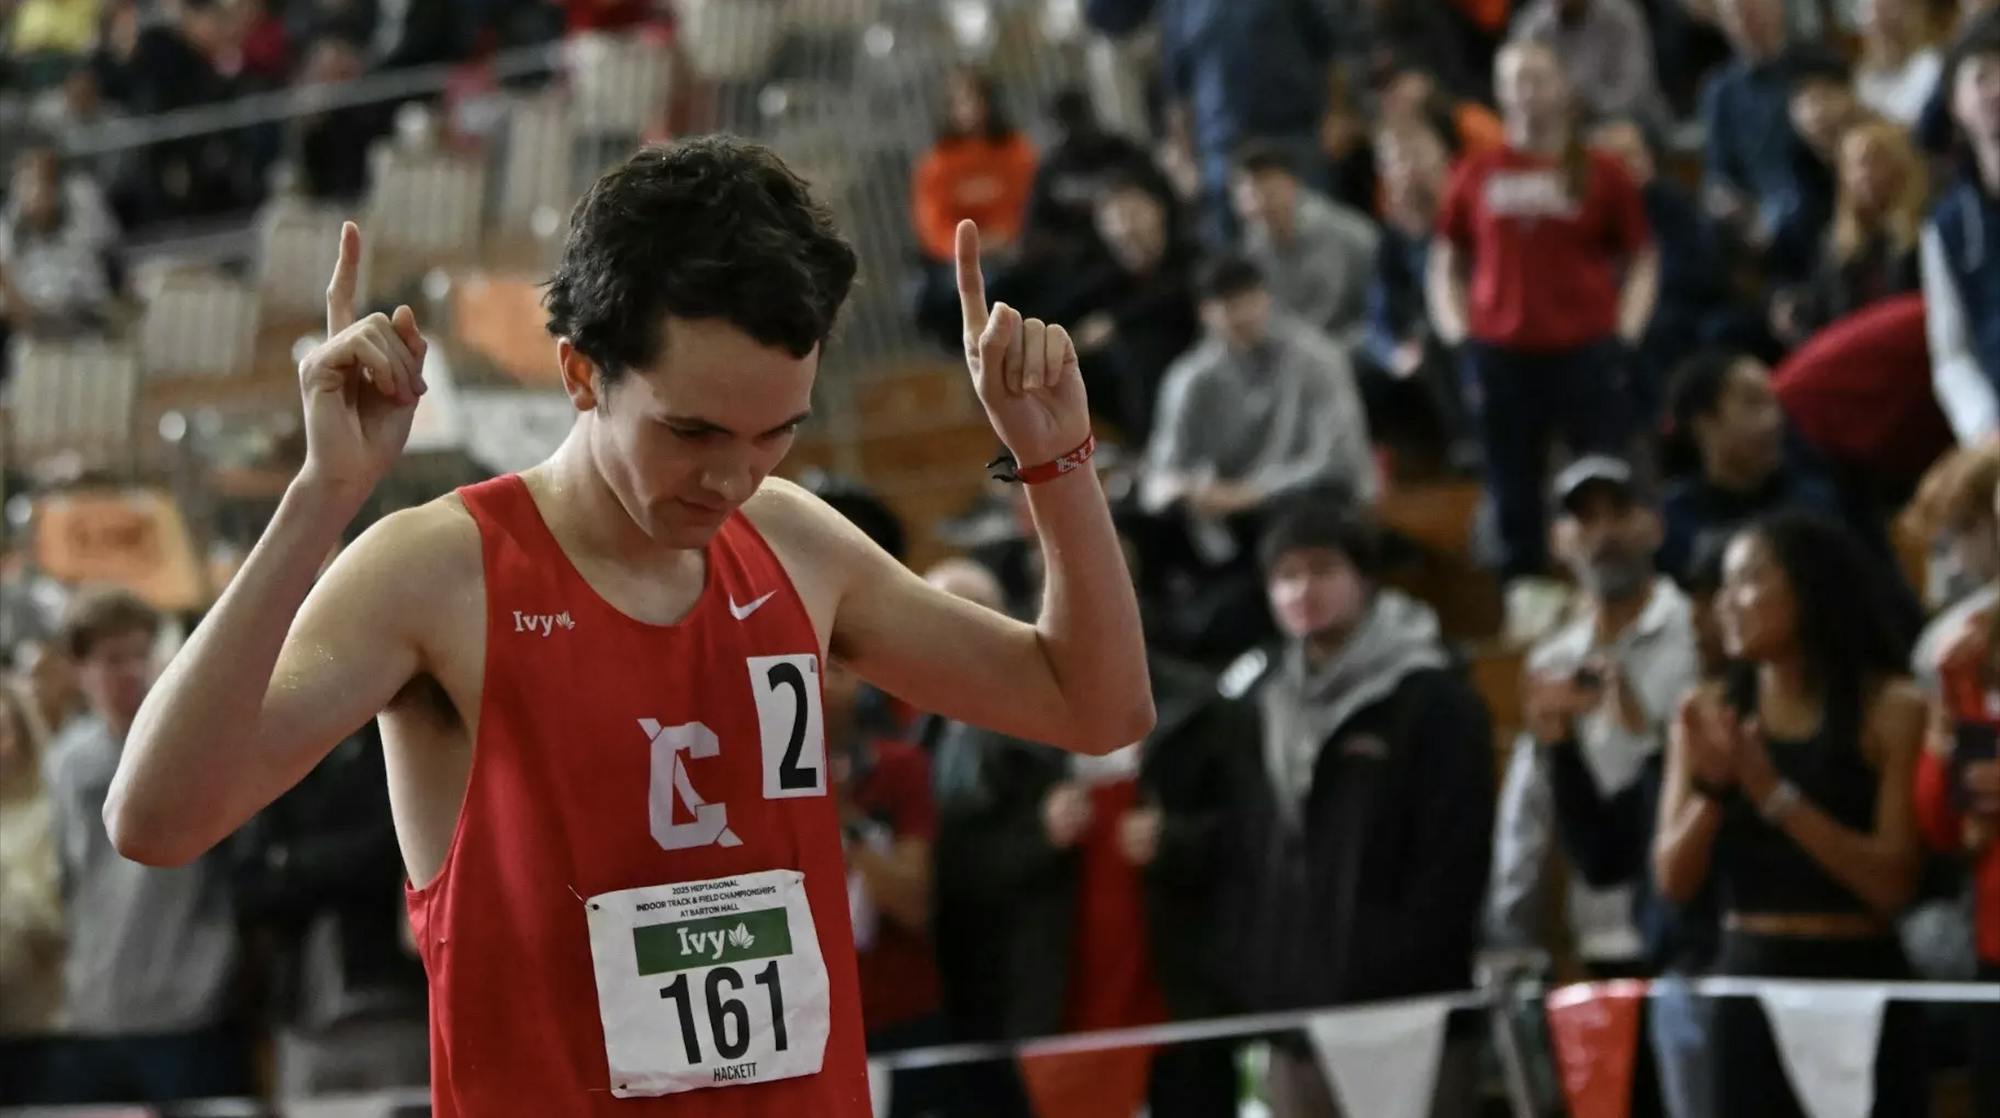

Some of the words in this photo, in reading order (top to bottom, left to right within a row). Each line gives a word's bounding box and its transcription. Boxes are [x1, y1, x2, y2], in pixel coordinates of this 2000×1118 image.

[513, 611, 554, 637] Ivy
[767, 662, 817, 789] 2
[637, 718, 744, 850] C
[636, 901, 666, 912] INDOOR
[667, 897, 691, 907] TRACK
[692, 896, 698, 904] &
[699, 893, 719, 903] FIELD
[720, 885, 777, 900] CHAMPIONSHIPS
[690, 880, 739, 892] HEPTAGONAL
[680, 909, 689, 918] AT
[690, 905, 720, 916] BARTON
[721, 903, 740, 911] HALL
[676, 927, 726, 960] Ivy
[659, 960, 788, 1064] 161
[713, 1062, 757, 1081] HACKETT
